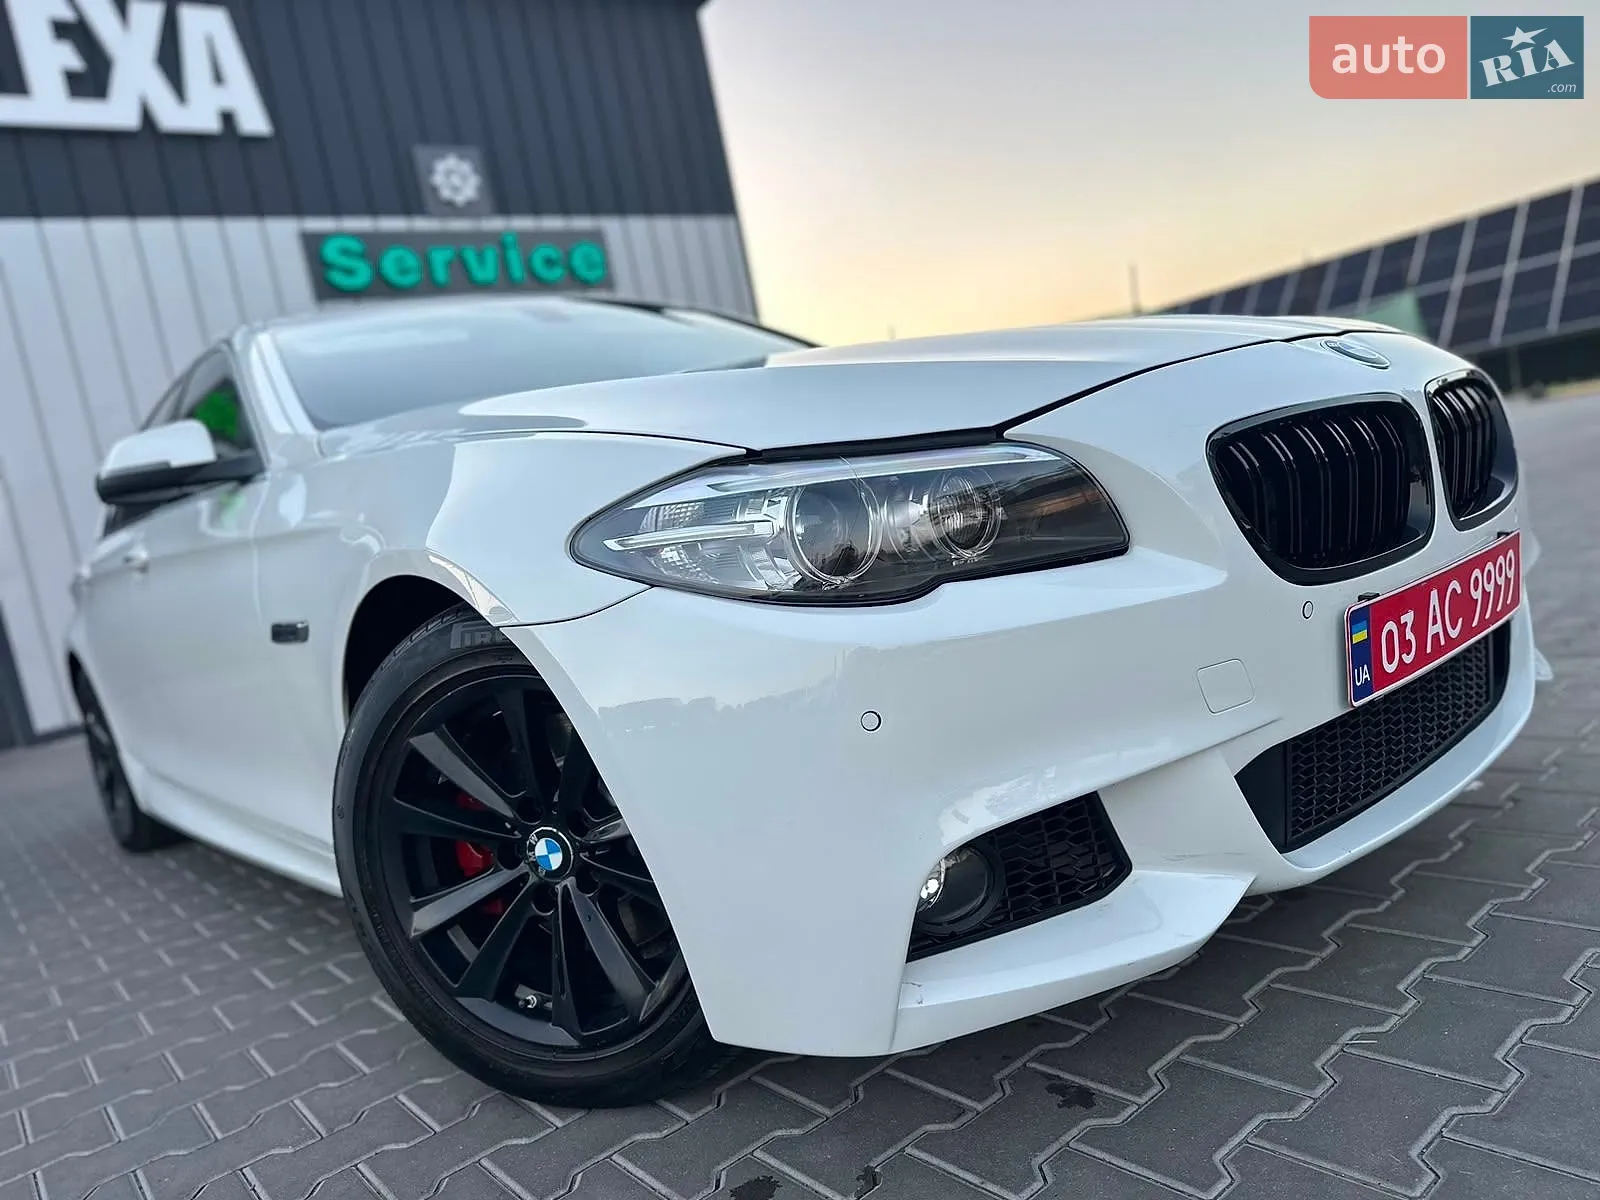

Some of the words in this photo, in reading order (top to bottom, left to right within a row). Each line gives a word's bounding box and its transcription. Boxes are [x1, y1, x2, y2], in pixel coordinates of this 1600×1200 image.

[319, 231, 608, 293] Service
[1381, 609, 1416, 674] 03
[1426, 579, 1462, 654] AC
[1470, 549, 1515, 628] 9999
[1355, 664, 1371, 686] UA
